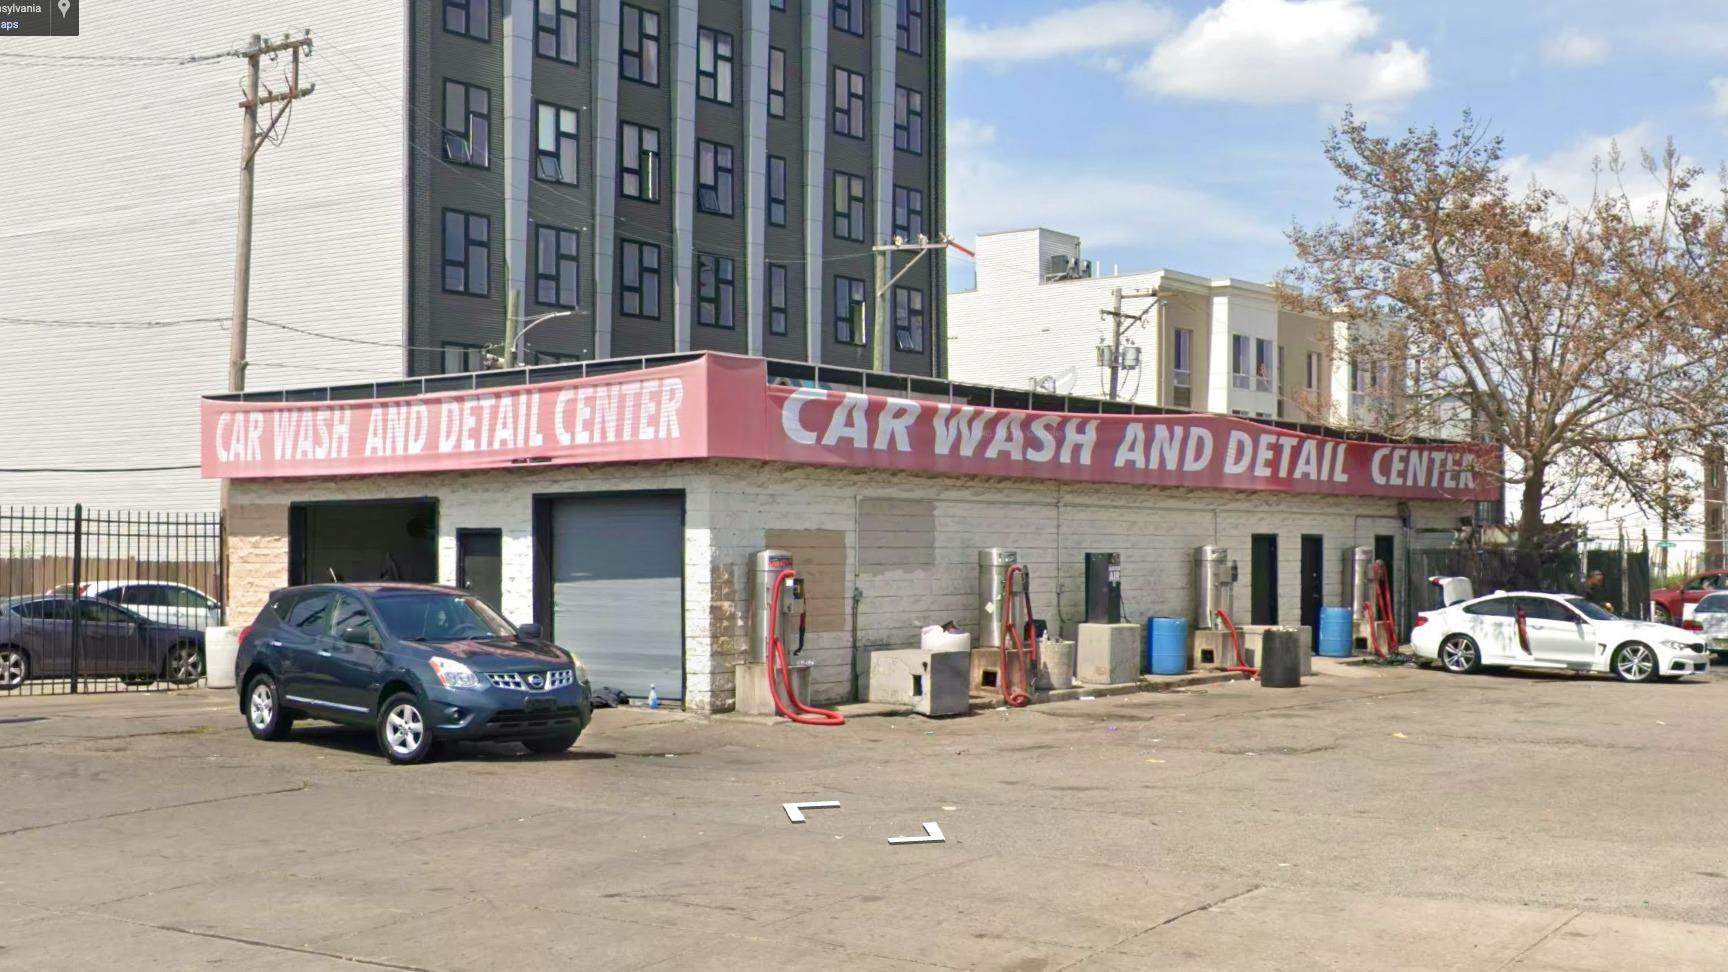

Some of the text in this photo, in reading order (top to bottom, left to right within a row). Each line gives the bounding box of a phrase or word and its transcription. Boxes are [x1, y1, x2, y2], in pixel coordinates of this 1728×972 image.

[217, 378, 683, 461] CAR WASH AND DETAIL CENTER
[782, 387, 921, 451] CAR
[932, 403, 1100, 465] WASH
[1114, 422, 1213, 471] AND
[1223, 431, 1347, 482] DETAIL
